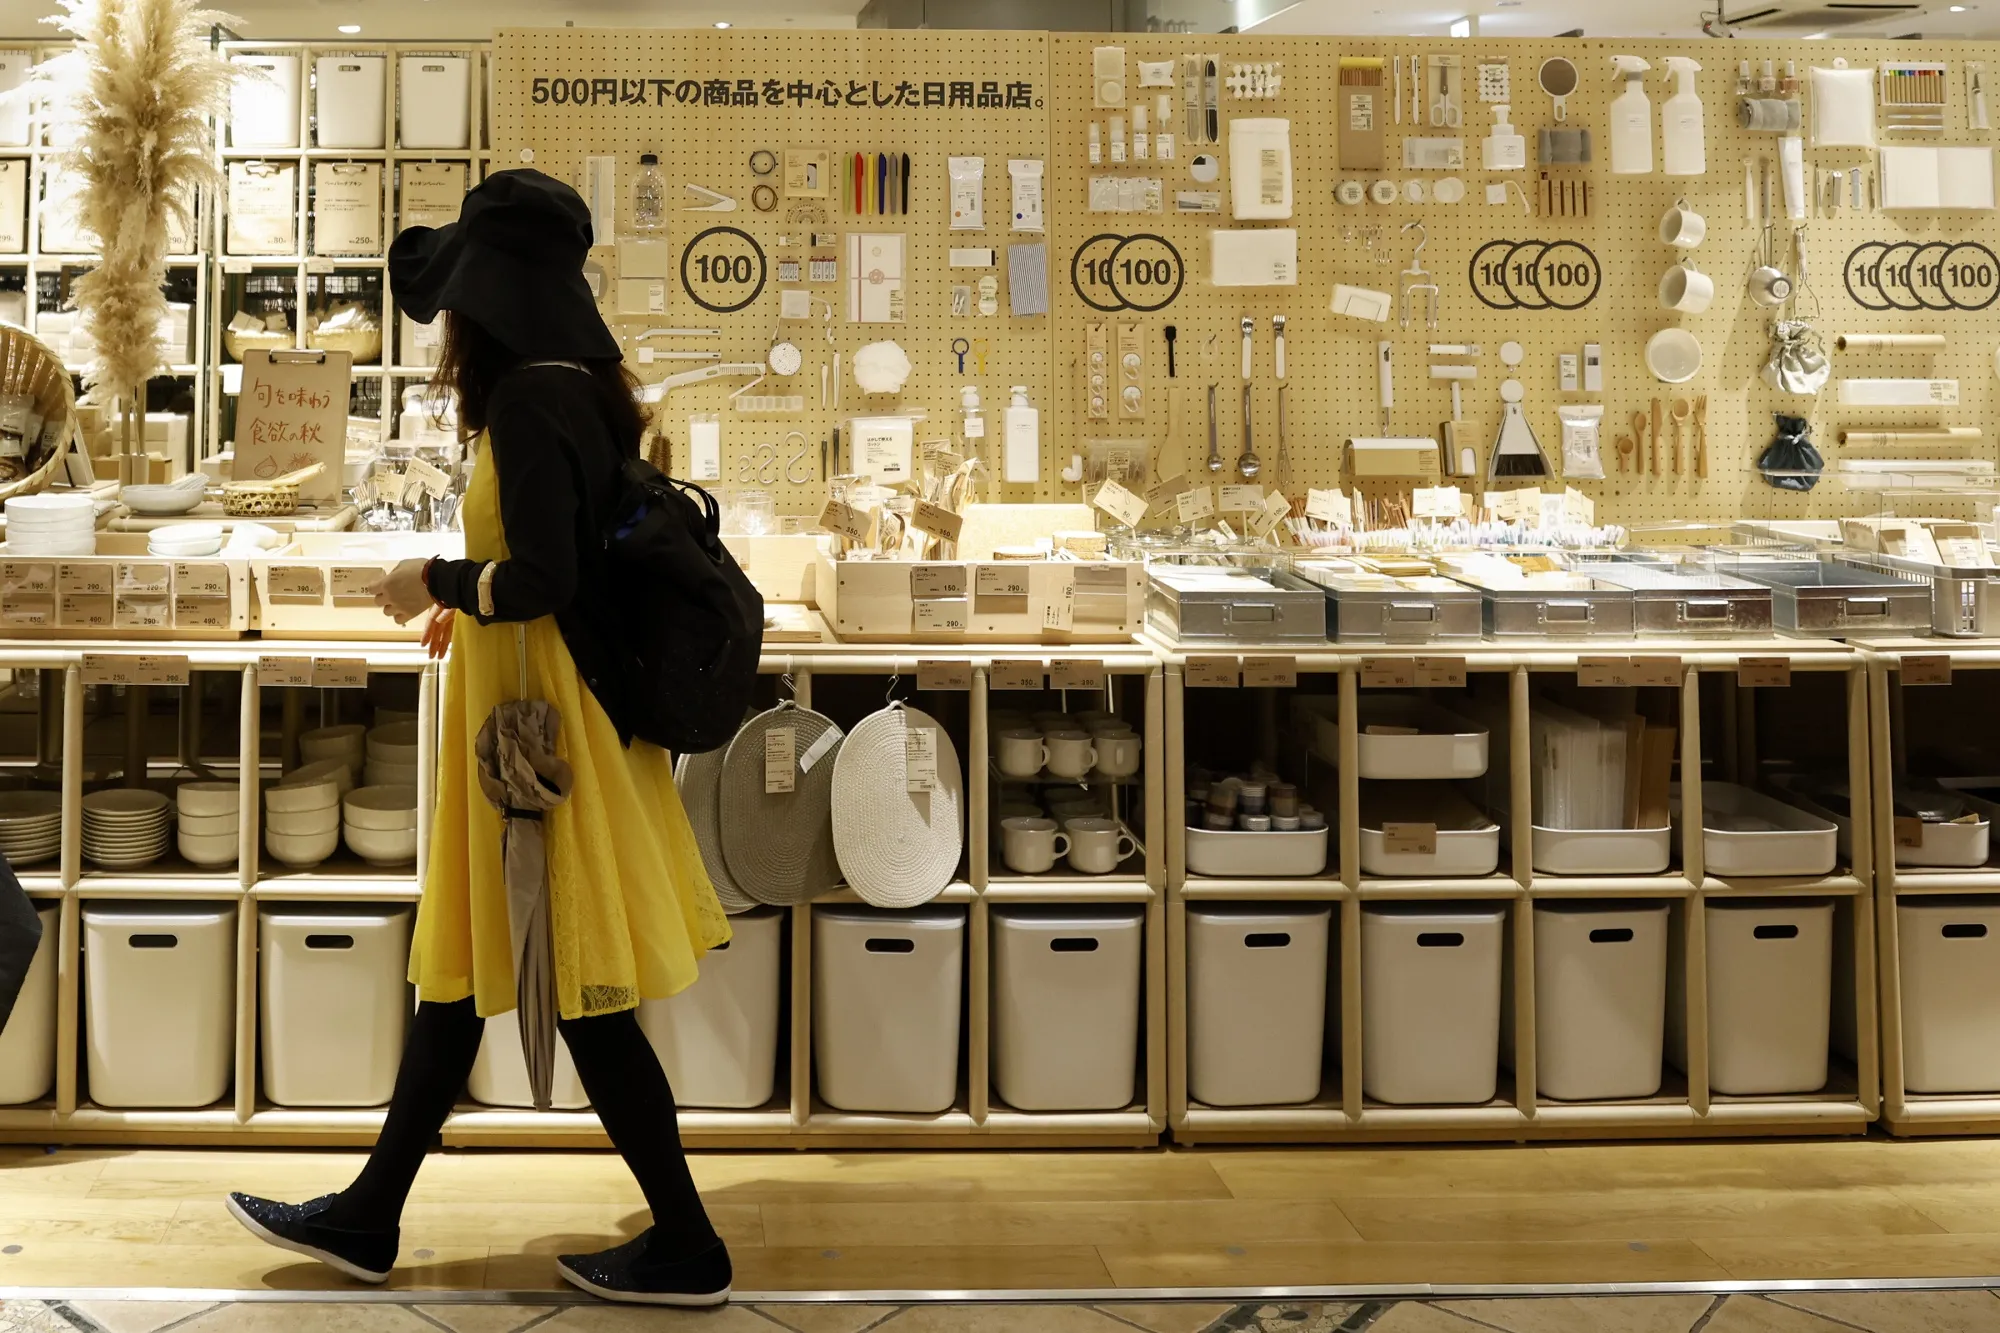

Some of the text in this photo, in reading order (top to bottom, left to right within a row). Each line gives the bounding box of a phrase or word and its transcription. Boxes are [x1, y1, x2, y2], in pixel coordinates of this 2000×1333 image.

[531, 77, 1044, 109] 500円以下の商品を中心とした日用品店。
[695, 254, 752, 284] 100
[1120, 259, 1171, 285] 100
[1544, 263, 1590, 286] 100
[1948, 264, 1992, 287] 100
[249, 417, 324, 445] 食欲の秋
[944, 584, 956, 592] 150
[1007, 584, 1020, 592] 290
[143, 617, 156, 625] 290
[203, 617, 216, 625] 490
